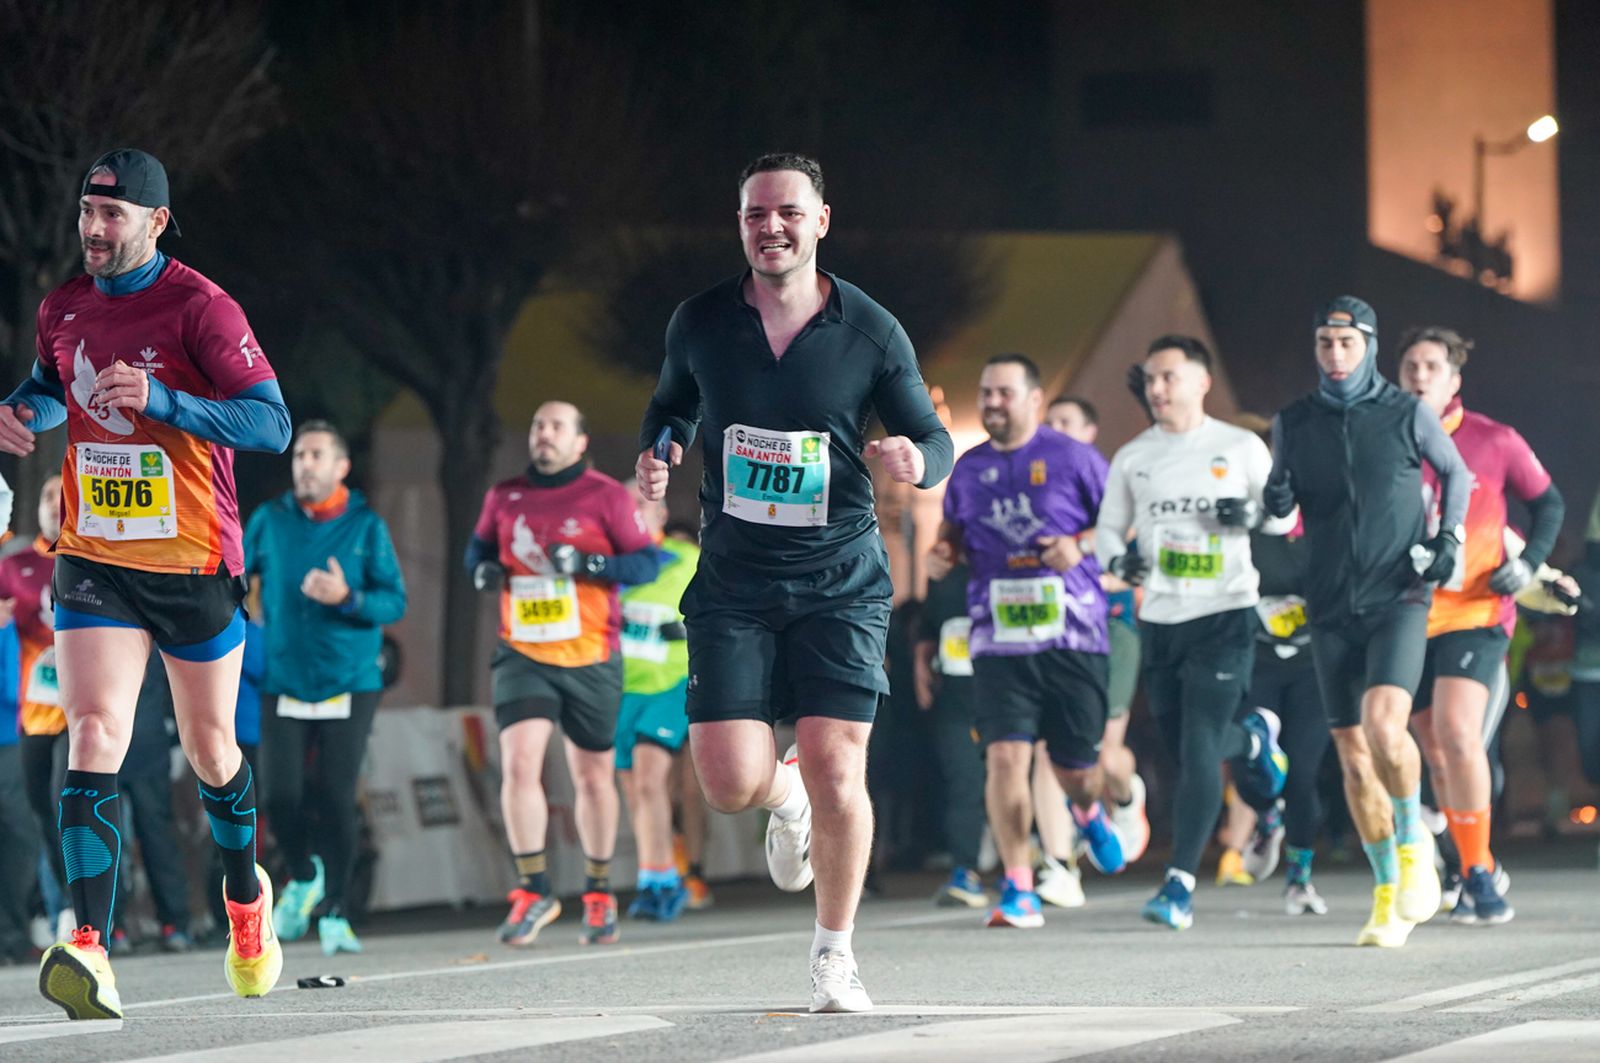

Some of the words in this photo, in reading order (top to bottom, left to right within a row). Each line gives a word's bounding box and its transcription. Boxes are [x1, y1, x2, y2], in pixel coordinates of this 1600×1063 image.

[735, 445, 755, 458] SAN
[746, 437, 777, 451] NOCHE
[779, 442, 792, 452] DE
[93, 454, 117, 465] NOCHE
[119, 456, 131, 465] DE
[84, 464, 99, 475] SAN
[747, 461, 805, 494] 7787
[91, 478, 153, 508] 5676
[1149, 497, 1216, 517] CAZO
